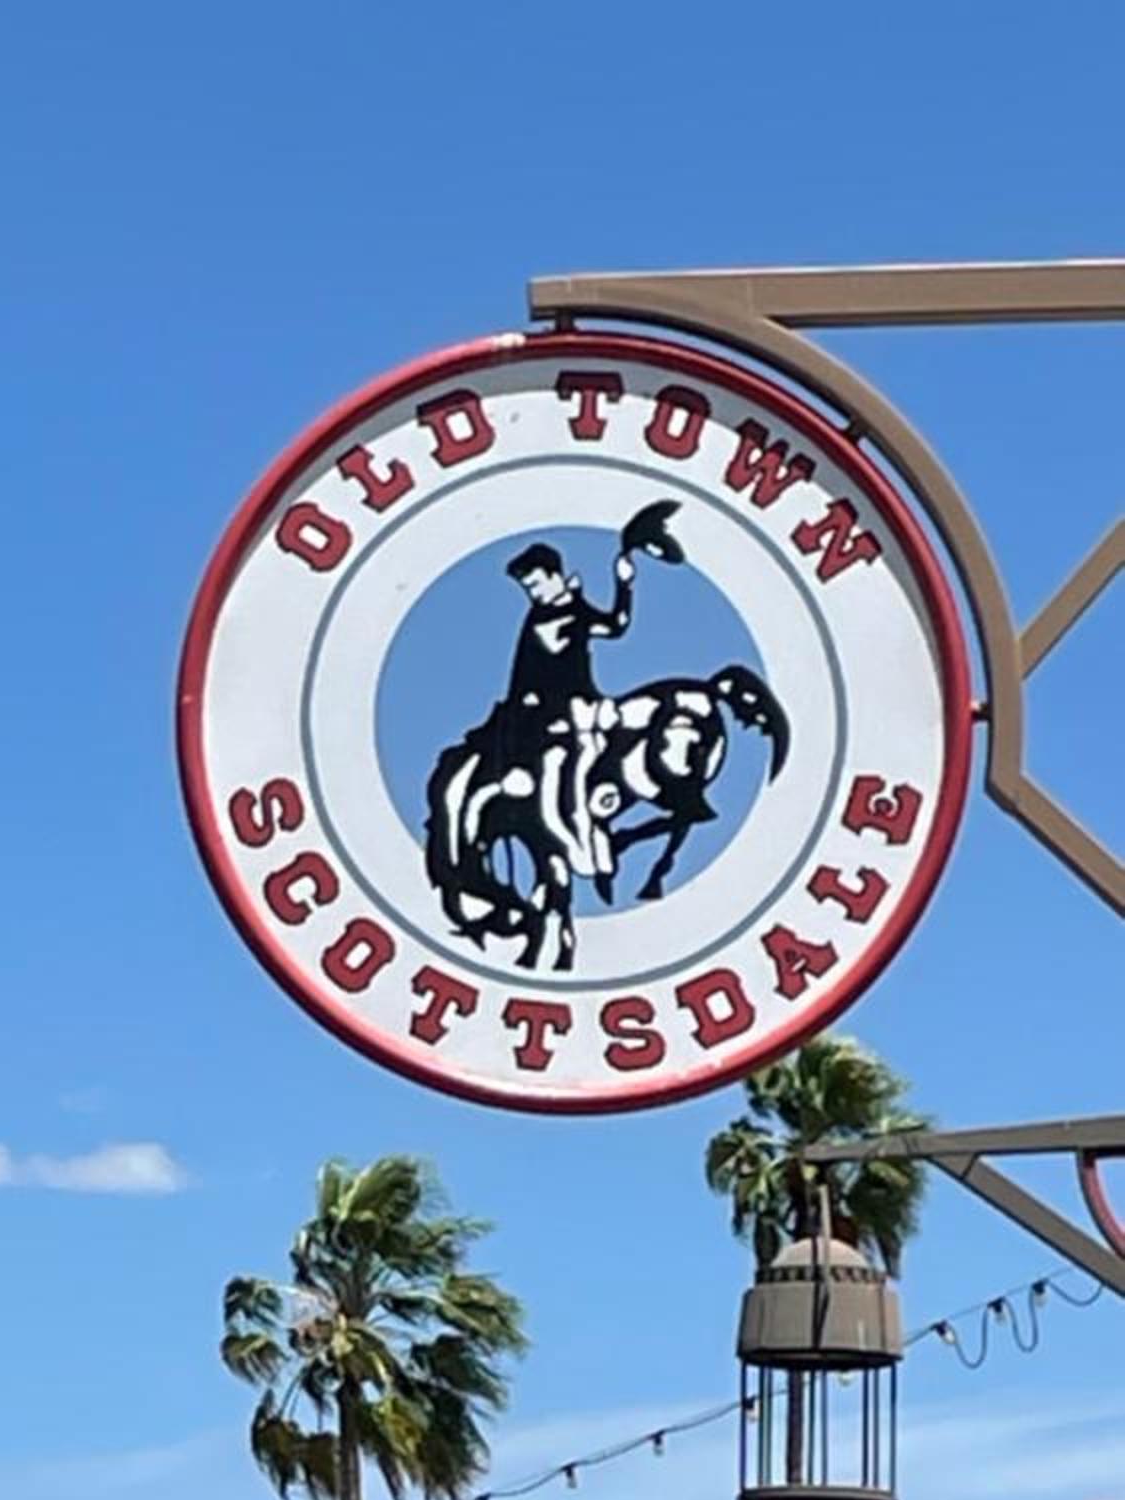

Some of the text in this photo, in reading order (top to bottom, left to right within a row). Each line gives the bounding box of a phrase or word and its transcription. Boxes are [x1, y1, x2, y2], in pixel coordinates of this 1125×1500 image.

[275, 370, 884, 585] OLD TOWN
[228, 774, 924, 1073] SCOTTSDALE
